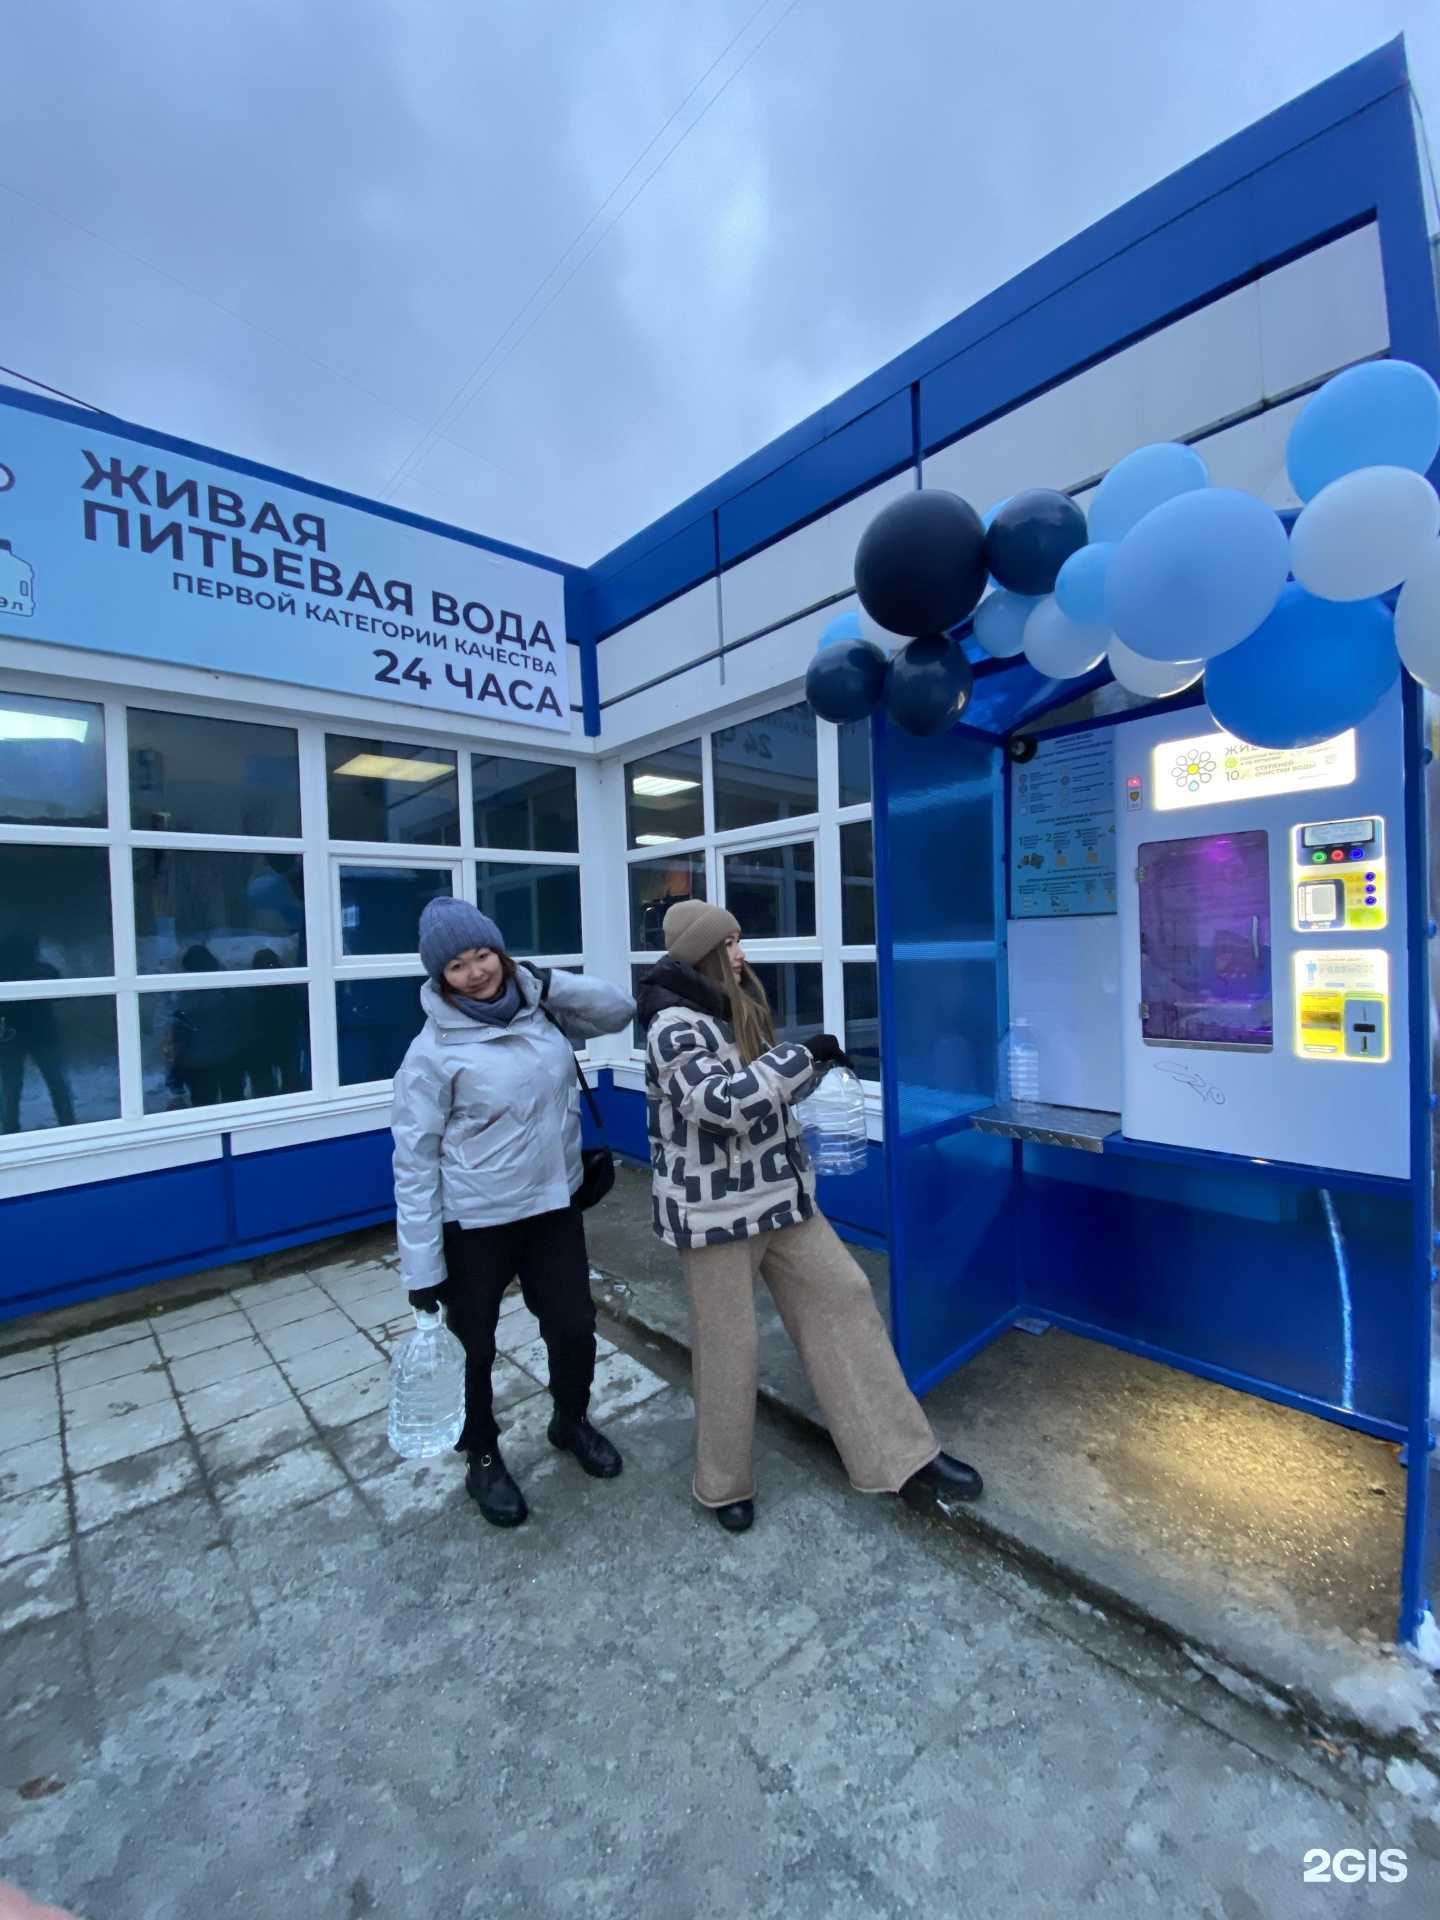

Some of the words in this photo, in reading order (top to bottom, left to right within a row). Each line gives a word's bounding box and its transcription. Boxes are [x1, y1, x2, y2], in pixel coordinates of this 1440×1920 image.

[80, 449, 326, 553] ЖИВАЯ
[83, 499, 414, 617] ПИТЬЕВАЯ
[431, 590, 556, 653] ВОДА
[172, 571, 297, 616] ПЕРВОЙ
[305, 601, 448, 650] КАТЕГОРИИ
[454, 637, 558, 676] КАЧЕСТВА
[372, 648, 432, 691] 24
[444, 663, 564, 718] ЧАСА
[1224, 770, 1240, 782] 10
